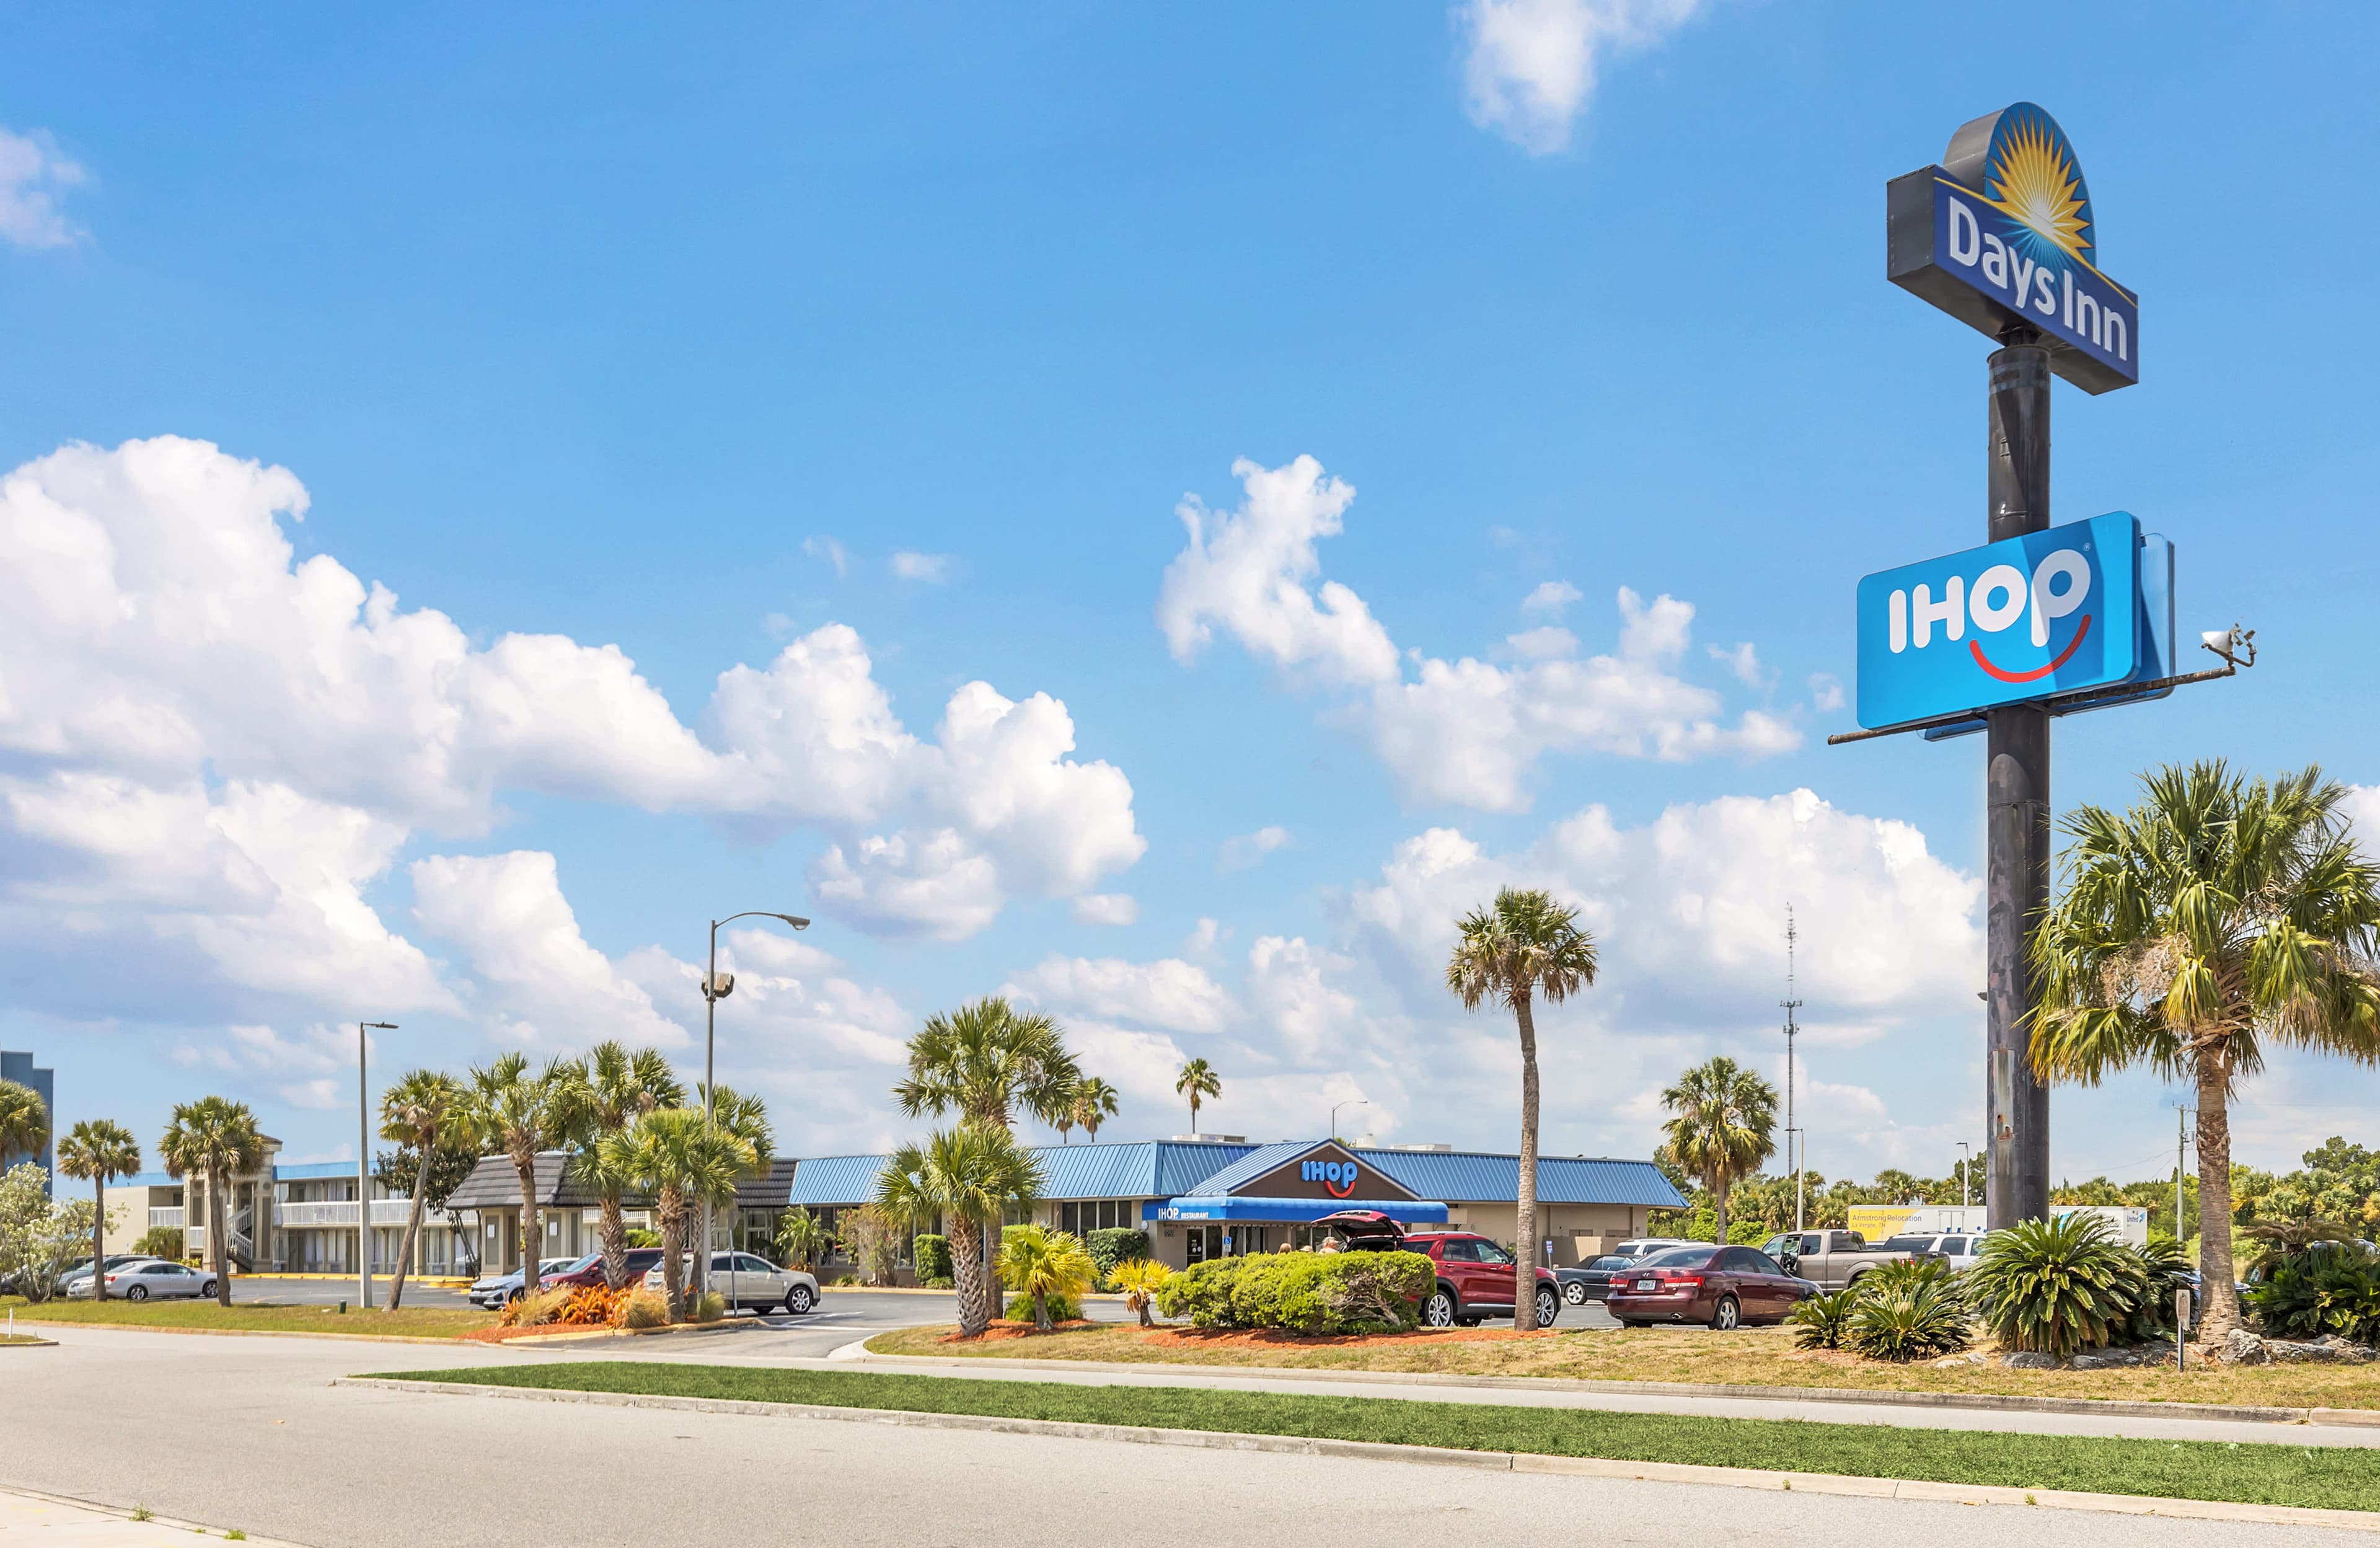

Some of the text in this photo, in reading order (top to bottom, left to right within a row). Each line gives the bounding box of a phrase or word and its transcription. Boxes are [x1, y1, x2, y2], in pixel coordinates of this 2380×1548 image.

[1949, 195, 2127, 361] Days Inn
[1889, 549, 2091, 653] IHOP
[1302, 1161, 1357, 1188] IHOP
